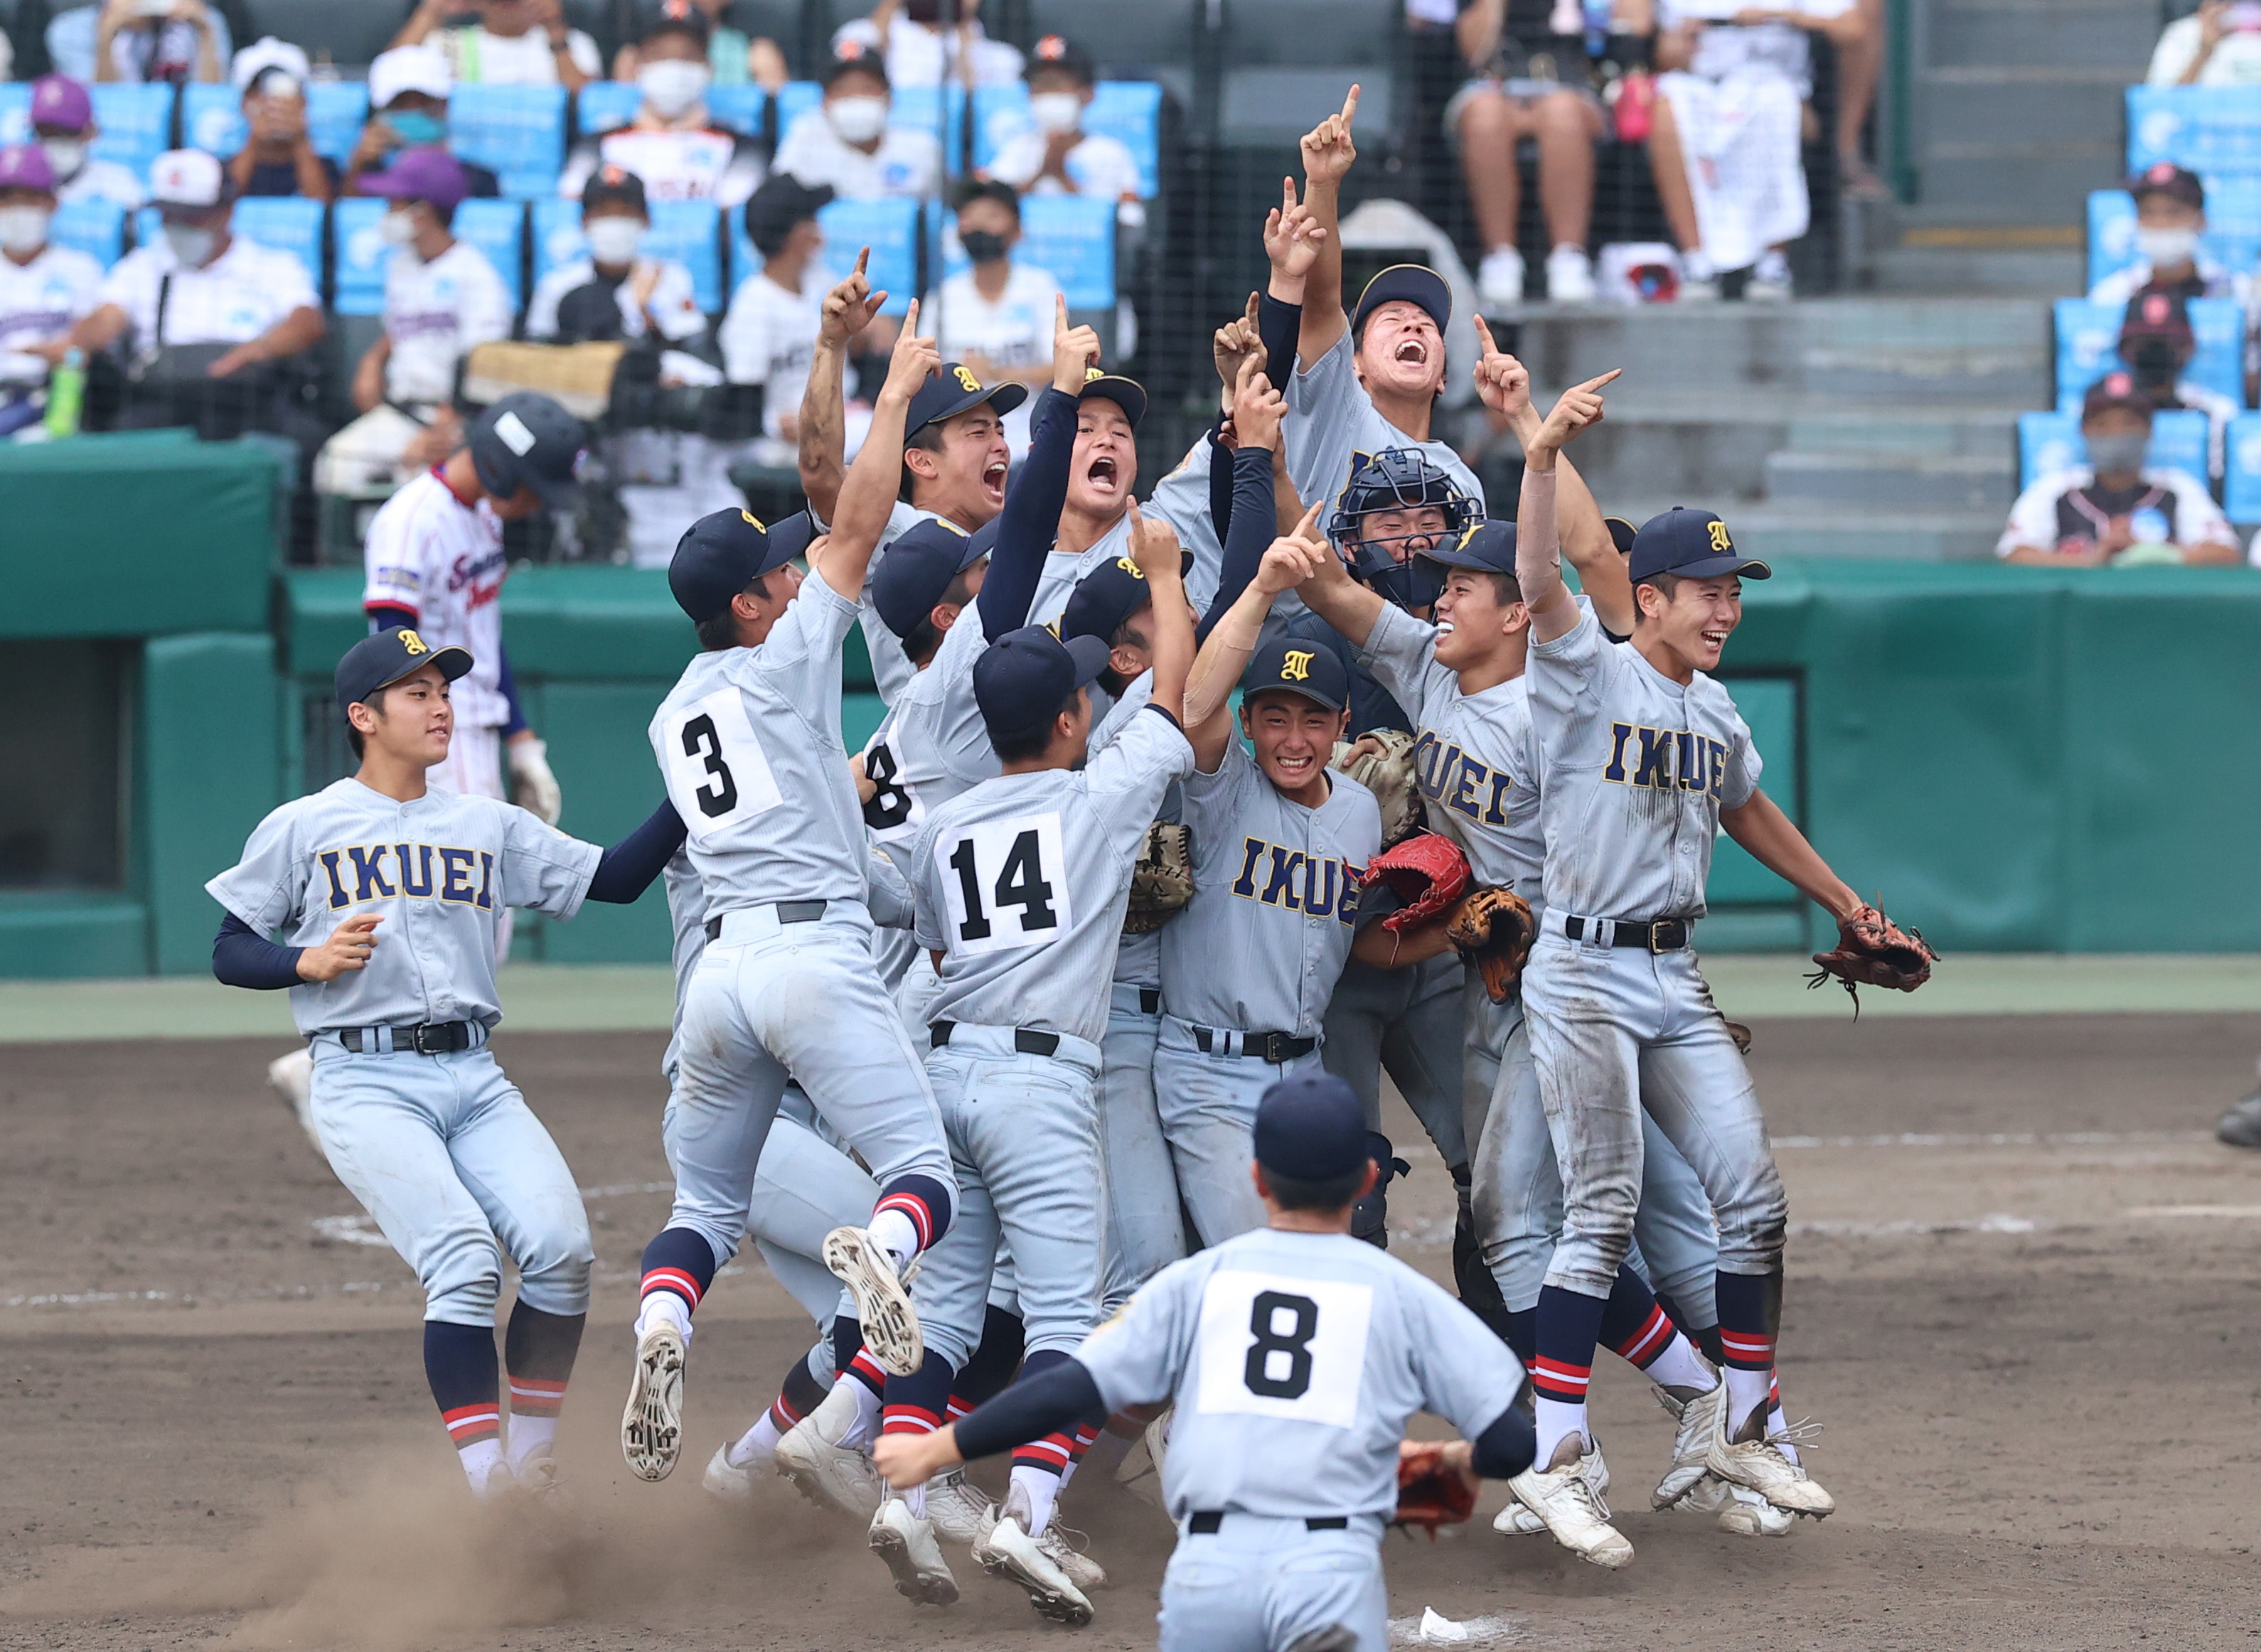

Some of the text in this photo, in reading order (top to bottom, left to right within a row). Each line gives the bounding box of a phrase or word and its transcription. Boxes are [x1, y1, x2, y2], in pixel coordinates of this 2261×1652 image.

[681, 713, 737, 818] 3
[1603, 721, 1731, 803] IKUE
[319, 842, 495, 912] IKUEI
[950, 829, 1057, 941] 14
[1244, 1290, 1318, 1399] 8
